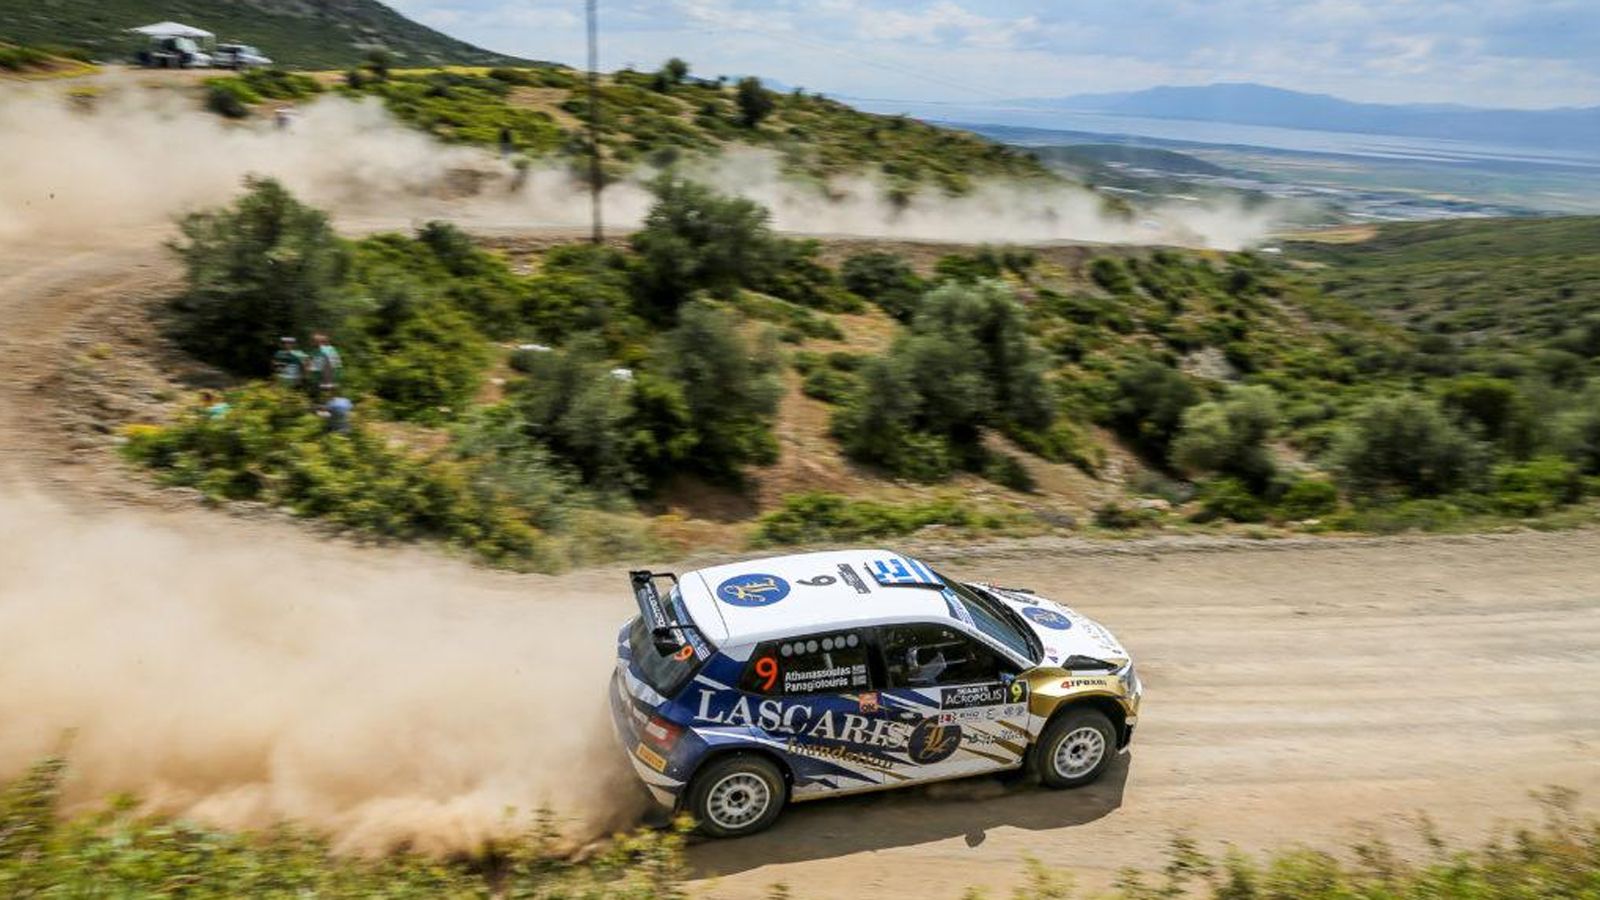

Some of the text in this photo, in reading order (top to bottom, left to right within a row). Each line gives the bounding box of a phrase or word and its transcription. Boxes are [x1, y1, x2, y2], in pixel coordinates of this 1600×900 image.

[796, 575, 836, 586] 9
[673, 645, 693, 661] 9
[755, 657, 778, 690] 9
[945, 690, 1002, 705] ACROPOLIS
[1011, 684, 1022, 703] 9
[693, 689, 902, 749] LASCARIS
